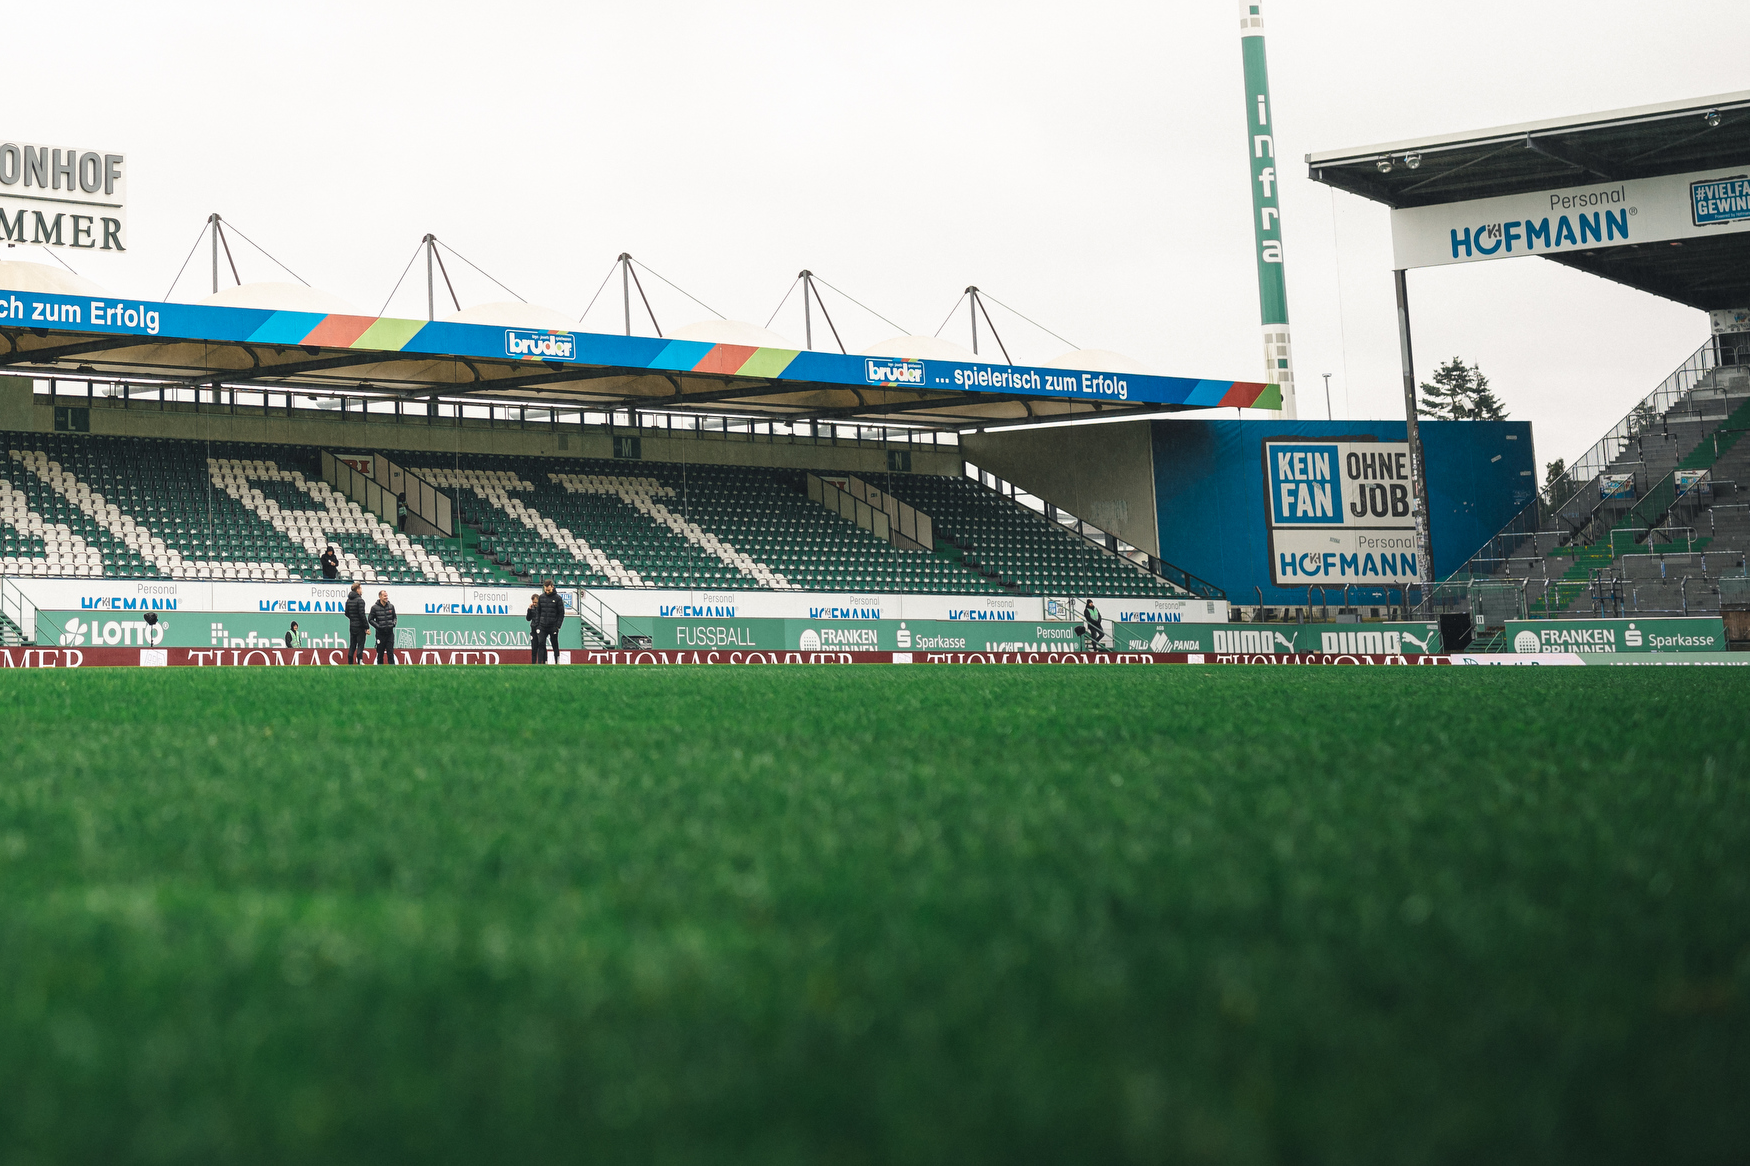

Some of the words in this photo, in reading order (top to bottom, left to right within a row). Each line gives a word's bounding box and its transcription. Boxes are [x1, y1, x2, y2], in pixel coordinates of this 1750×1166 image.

[1254, 94, 1283, 264] infra
[1549, 184, 1626, 211] Personal
[1450, 207, 1630, 259] HOFMANN
[31, 302, 82, 324] zum
[89, 300, 161, 334] Erfolg
[508, 332, 573, 357] bruder
[867, 360, 923, 383] bruder
[953, 367, 1041, 390] spielerisch
[1044, 377, 1078, 393] zum
[1081, 374, 1129, 400] Erfolg
[67, 408, 77, 430] L
[621, 439, 633, 457] M
[895, 452, 903, 470] N
[1277, 452, 1331, 481] KEIN
[1346, 452, 1409, 480] OHNE
[1280, 482, 1334, 518] FAN
[1358, 536, 1416, 549] Personal
[1280, 552, 1418, 577] HOFMANN
[137, 583, 178, 595] Personal
[311, 586, 348, 598] Personal
[473, 590, 509, 602] Personal
[703, 593, 735, 604] Personal
[849, 596, 880, 606] Personal
[986, 599, 1015, 608] Personal
[1154, 601, 1180, 610] Personal
[91, 620, 164, 646] LOTTO
[422, 630, 487, 646] THOMAS
[676, 626, 756, 646] FUSSBALL
[820, 629, 878, 644] FRANKEN
[1036, 626, 1074, 640] Personal
[1540, 629, 1616, 644] FRANKEN
[1648, 633, 1714, 649] Sparkasse
[915, 634, 966, 651] Sparkasse
[1128, 639, 1149, 650] WILD
[1172, 640, 1200, 651] PANDA
